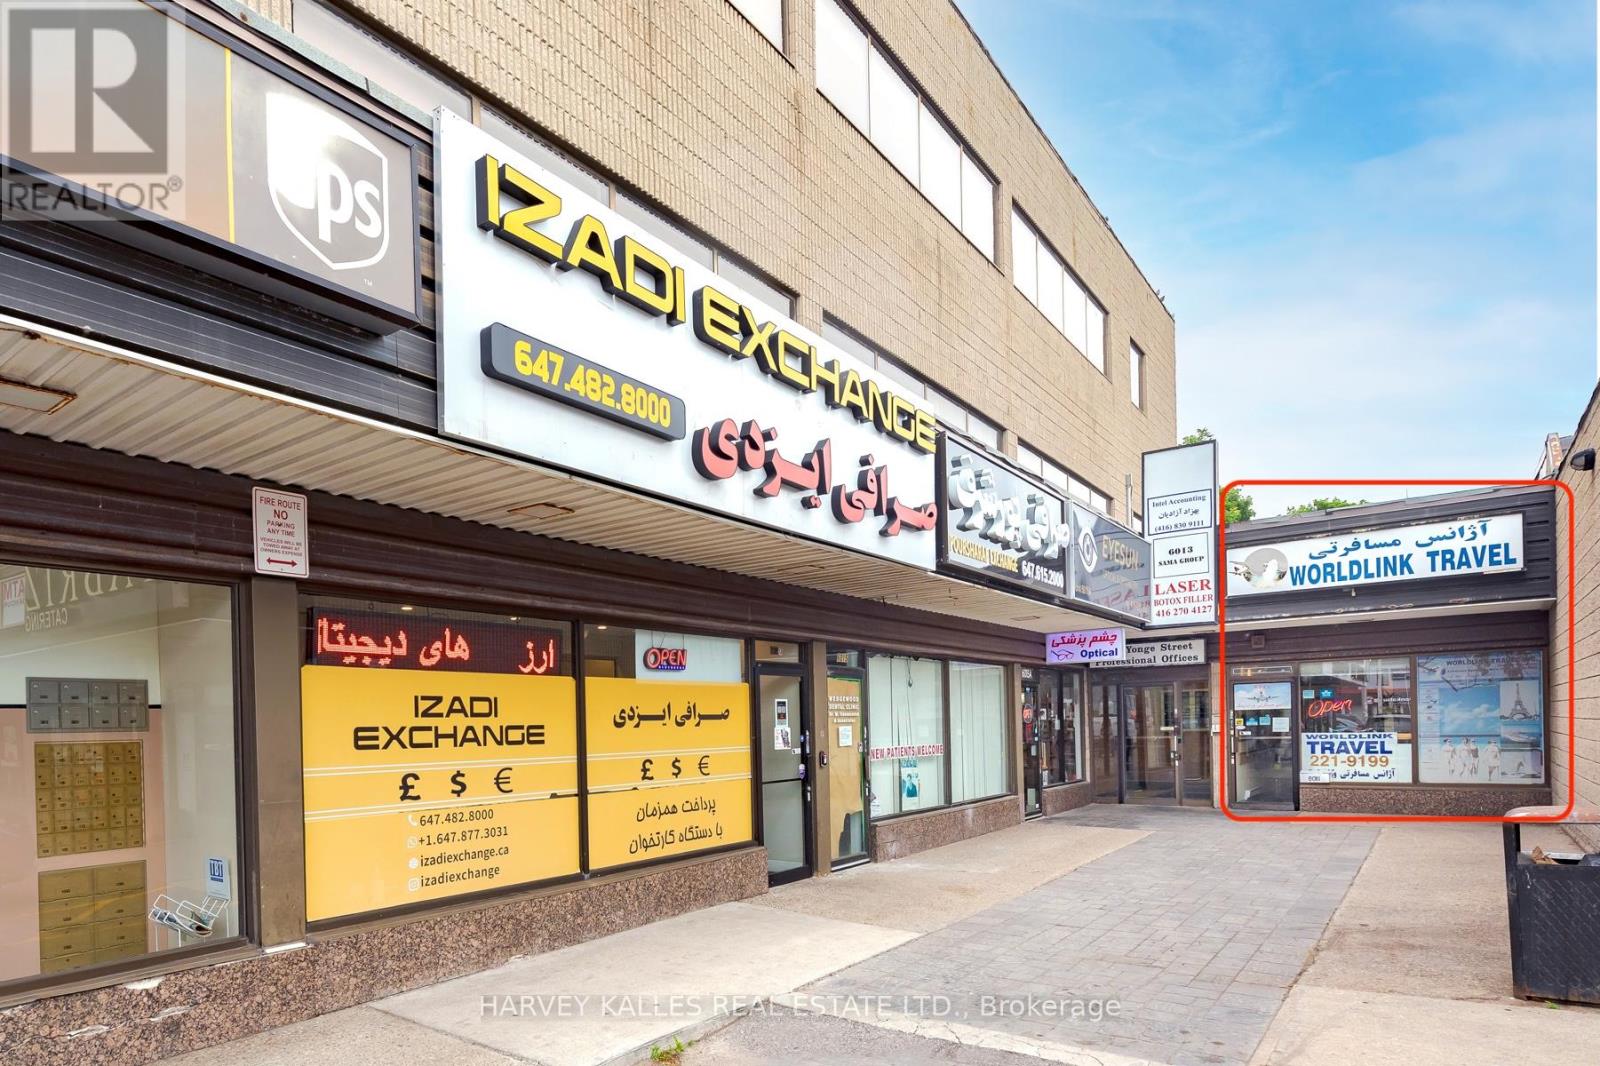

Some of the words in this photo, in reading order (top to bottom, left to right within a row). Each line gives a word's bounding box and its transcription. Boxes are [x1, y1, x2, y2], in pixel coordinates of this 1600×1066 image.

[477, 154, 686, 325] IZADI
[694, 285, 937, 454] EXCHANGE
[514, 340, 671, 428] 647.482.8000
[692, 418, 832, 509] ایزدی
[259, 496, 276, 507] FIRE
[277, 499, 301, 511] ROUTE
[832, 453, 938, 538] صرافی
[1153, 500, 1168, 508] Intel
[1169, 495, 1206, 505] Accounting
[273, 509, 289, 520] NO
[266, 519, 295, 530] PARKING
[267, 528, 280, 536] ANY
[281, 529, 295, 537] TIME
[1154, 524, 1173, 532] (416)
[1174, 521, 1187, 529] 830
[1188, 519, 1204, 527] 9111
[1415, 519, 1493, 548] آژانس
[1168, 546, 1193, 556] 6013
[1308, 537, 1402, 560] مسافرتی
[1158, 558, 1178, 566] SAMA
[1180, 555, 1205, 564] GROUP
[1289, 552, 1415, 586] WORLDLINK
[1427, 542, 1517, 572] TRAVEL
[1154, 578, 1212, 596] LASER
[1154, 596, 1182, 607] BOTOX
[1183, 593, 1214, 604] FILLER
[1156, 608, 1171, 617] 416
[1173, 606, 1189, 616] 270
[1191, 604, 1213, 614] 4127
[419, 627, 470, 667] های
[1051, 633, 1087, 648] پزشکی
[1089, 632, 1118, 647] چشم
[518, 639, 554, 674] ارز
[1080, 648, 1119, 659] Optical
[1126, 645, 1155, 655] Yonge
[1161, 643, 1193, 651] Street
[1161, 653, 1199, 663] Offices
[647, 648, 687, 669] OPEN
[413, 695, 498, 718] IZADI
[613, 701, 671, 729] ایزدی
[674, 701, 730, 727] صرافی
[1308, 700, 1352, 718] Open
[353, 725, 545, 751] EXCHANGE
[870, 748, 885, 759] NEW
[887, 746, 915, 757] PATIENTS
[917, 744, 943, 756] WELCOME
[1307, 740, 1393, 755] TRAVEL
[1310, 755, 1389, 767] 221-9199
[1374, 768, 1396, 780] آژانس
[636, 802, 678, 822] همزمان
[681, 796, 716, 816] پرداخت
[419, 808, 494, 827] 647.482.8000
[419, 825, 509, 846] +1.647.877.3031
[678, 825, 713, 843] دستگاه
[715, 822, 723, 839] با
[629, 829, 675, 854] کارتخوان
[420, 846, 509, 868] izadiexchange.ca
[420, 865, 500, 888] izadiexchange
